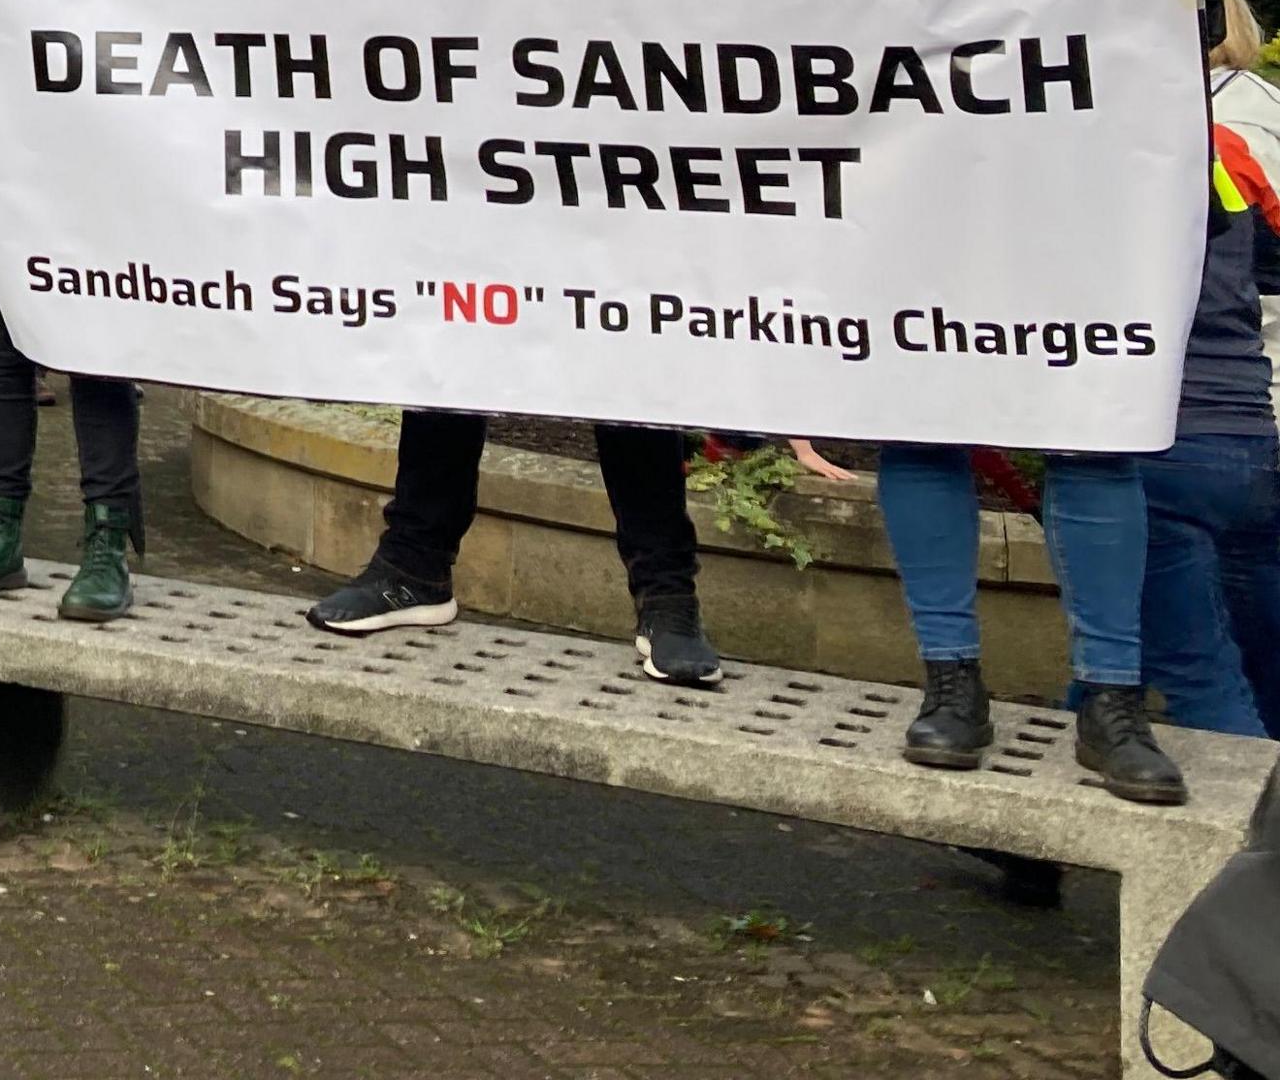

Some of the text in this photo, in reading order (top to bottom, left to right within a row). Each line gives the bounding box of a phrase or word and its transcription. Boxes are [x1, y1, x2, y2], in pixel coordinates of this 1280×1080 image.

[30, 30, 1094, 116] DEATH OF SANDBACH
[224, 130, 861, 220] HIGH STREET
[27, 256, 1157, 367] Sandbach Says "NO" To Parking Charges
